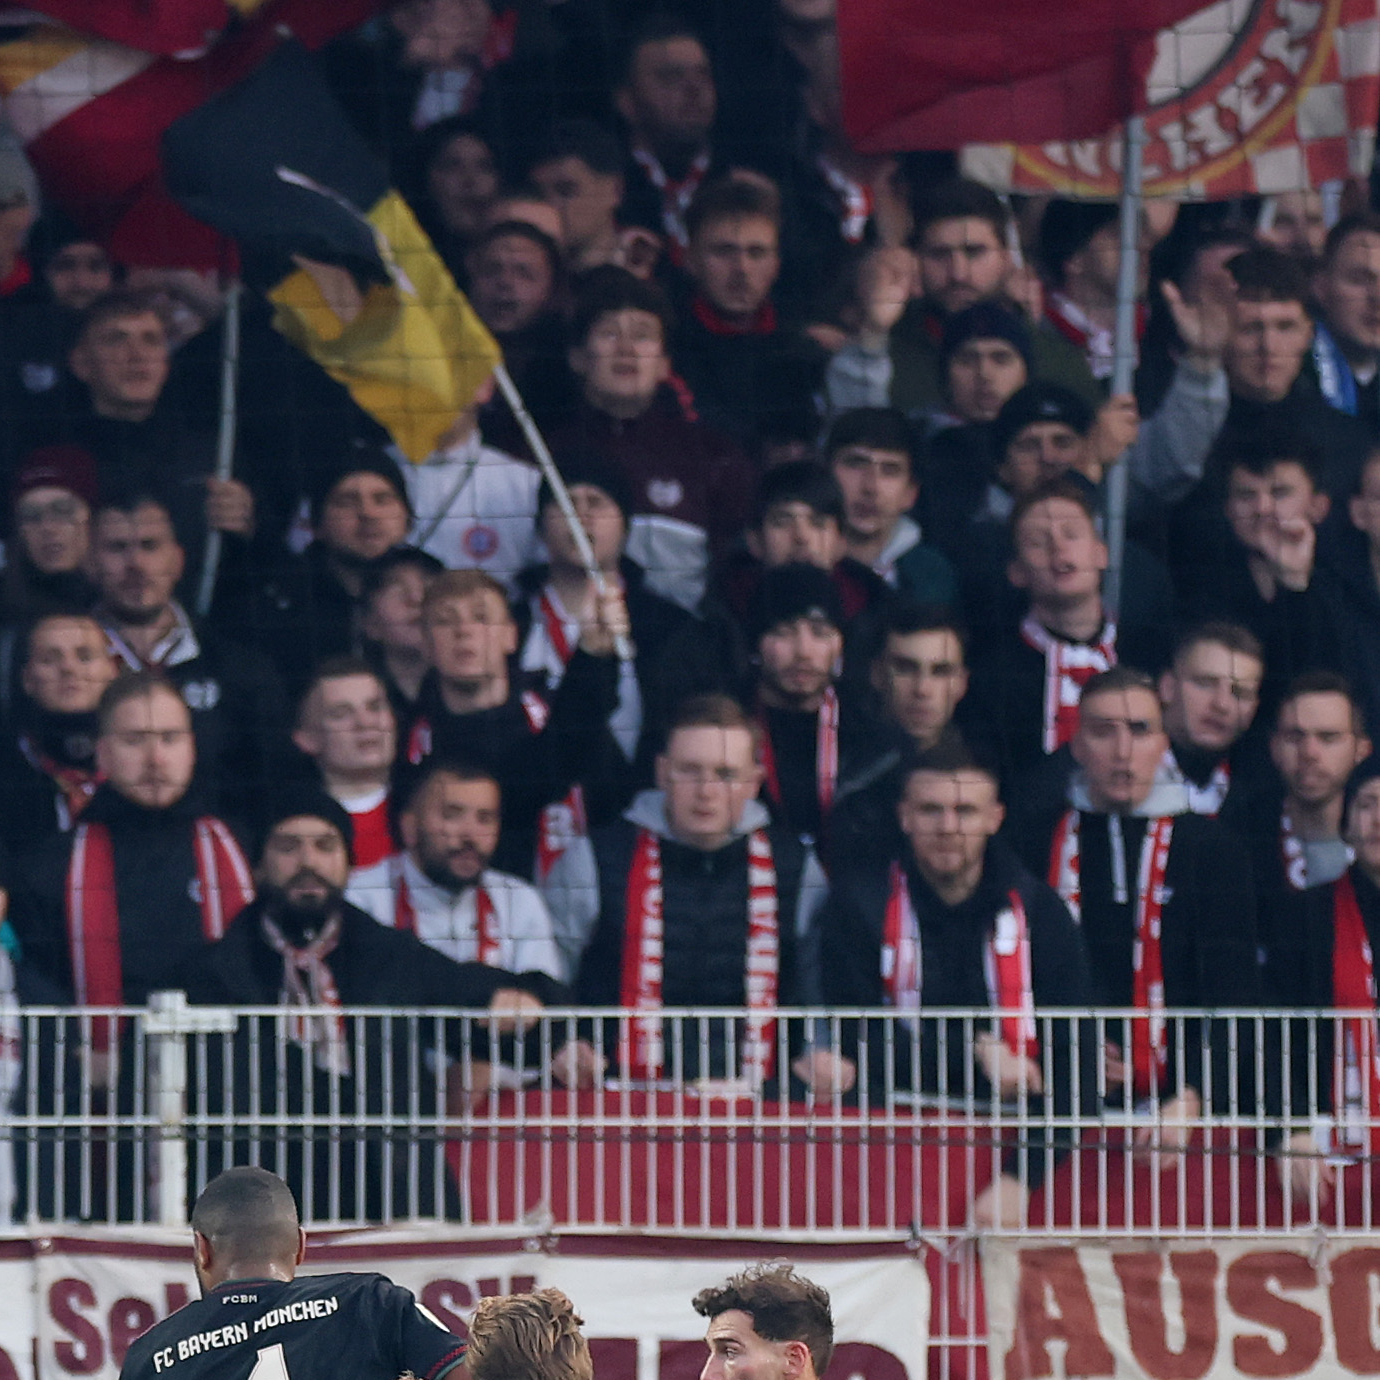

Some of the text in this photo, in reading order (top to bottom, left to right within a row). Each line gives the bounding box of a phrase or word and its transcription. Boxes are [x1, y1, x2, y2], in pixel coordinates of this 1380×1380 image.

[152, 1296, 339, 1374] FC BAYERN MÜNCHEN
